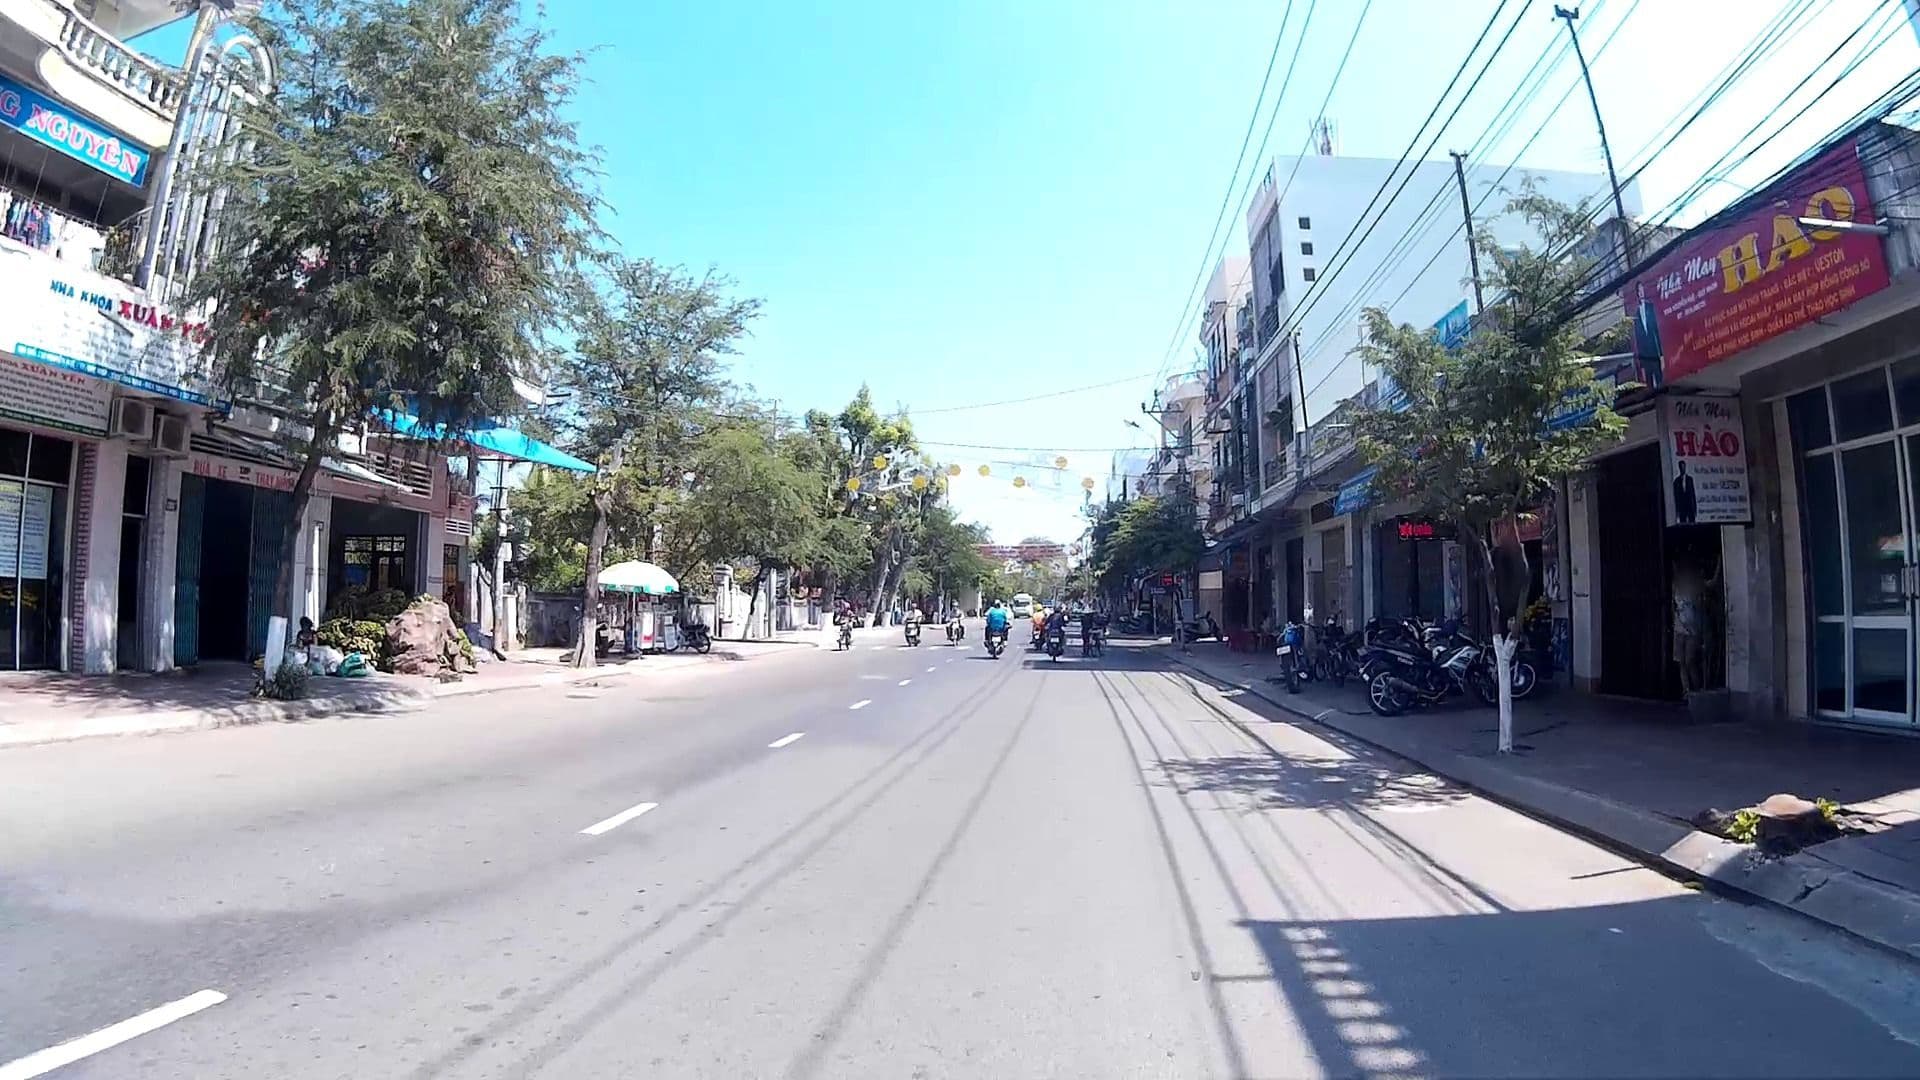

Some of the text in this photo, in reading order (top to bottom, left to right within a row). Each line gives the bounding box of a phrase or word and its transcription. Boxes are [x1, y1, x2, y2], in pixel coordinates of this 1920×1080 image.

[0, 87, 140, 176] G NGUYÊN
[1717, 186, 1856, 293] HÀO
[1684, 256, 1718, 282] May
[50, 279, 75, 298] NHA
[80, 289, 114, 312] KHOA
[1674, 423, 1740, 457] HÀO
